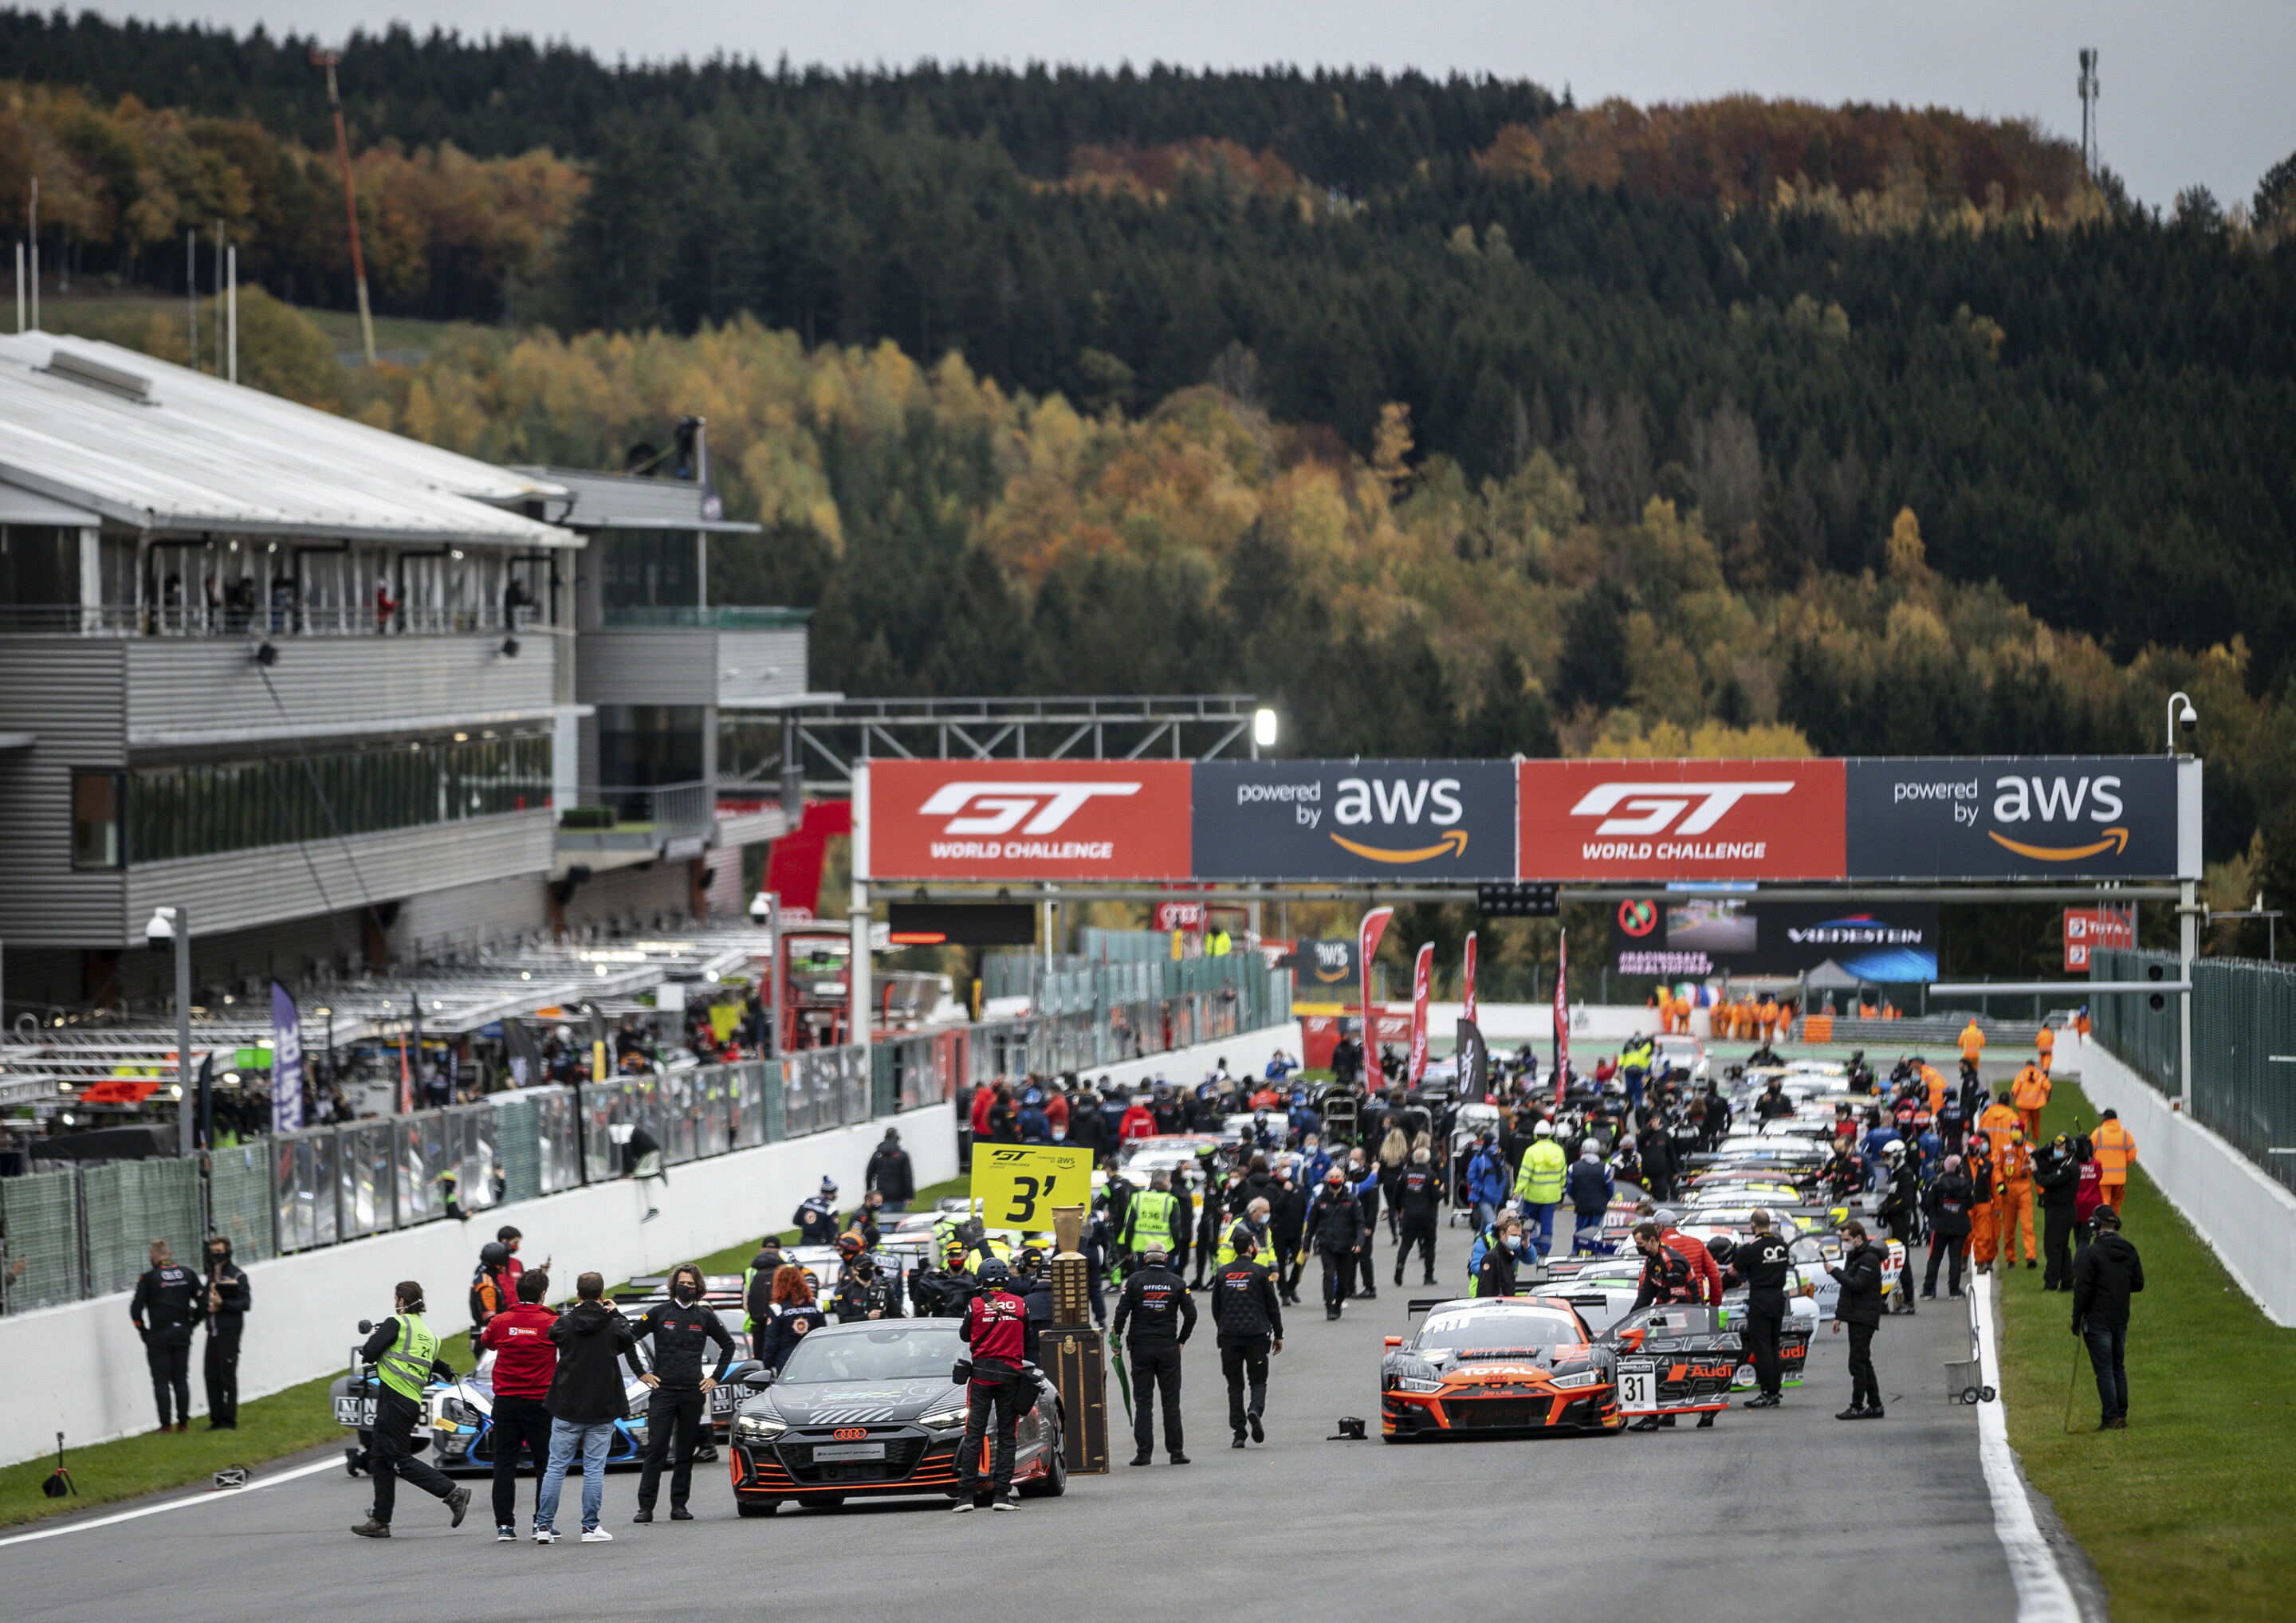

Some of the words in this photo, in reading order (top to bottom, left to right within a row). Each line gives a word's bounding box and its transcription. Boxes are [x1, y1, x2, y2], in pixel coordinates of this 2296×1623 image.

[1237, 781, 1320, 804] powered
[1335, 778, 1463, 826] aws
[1894, 779, 1978, 804] powered
[1994, 775, 2122, 823] aws
[918, 782, 1142, 835] GT
[1296, 804, 1321, 827] by
[1570, 781, 1795, 835] GT
[1954, 800, 1978, 826] by
[930, 842, 1000, 859] WORLD
[1005, 842, 1113, 859] CHALLENGE
[1582, 842, 1653, 860] WORLD
[1657, 842, 1765, 859] CHALLENGE
[1779, 1345, 1805, 1358] udi
[1460, 1366, 1532, 1376] TOTAL
[1690, 1364, 1732, 1378] Audi
[1624, 1376, 1645, 1401] 31
